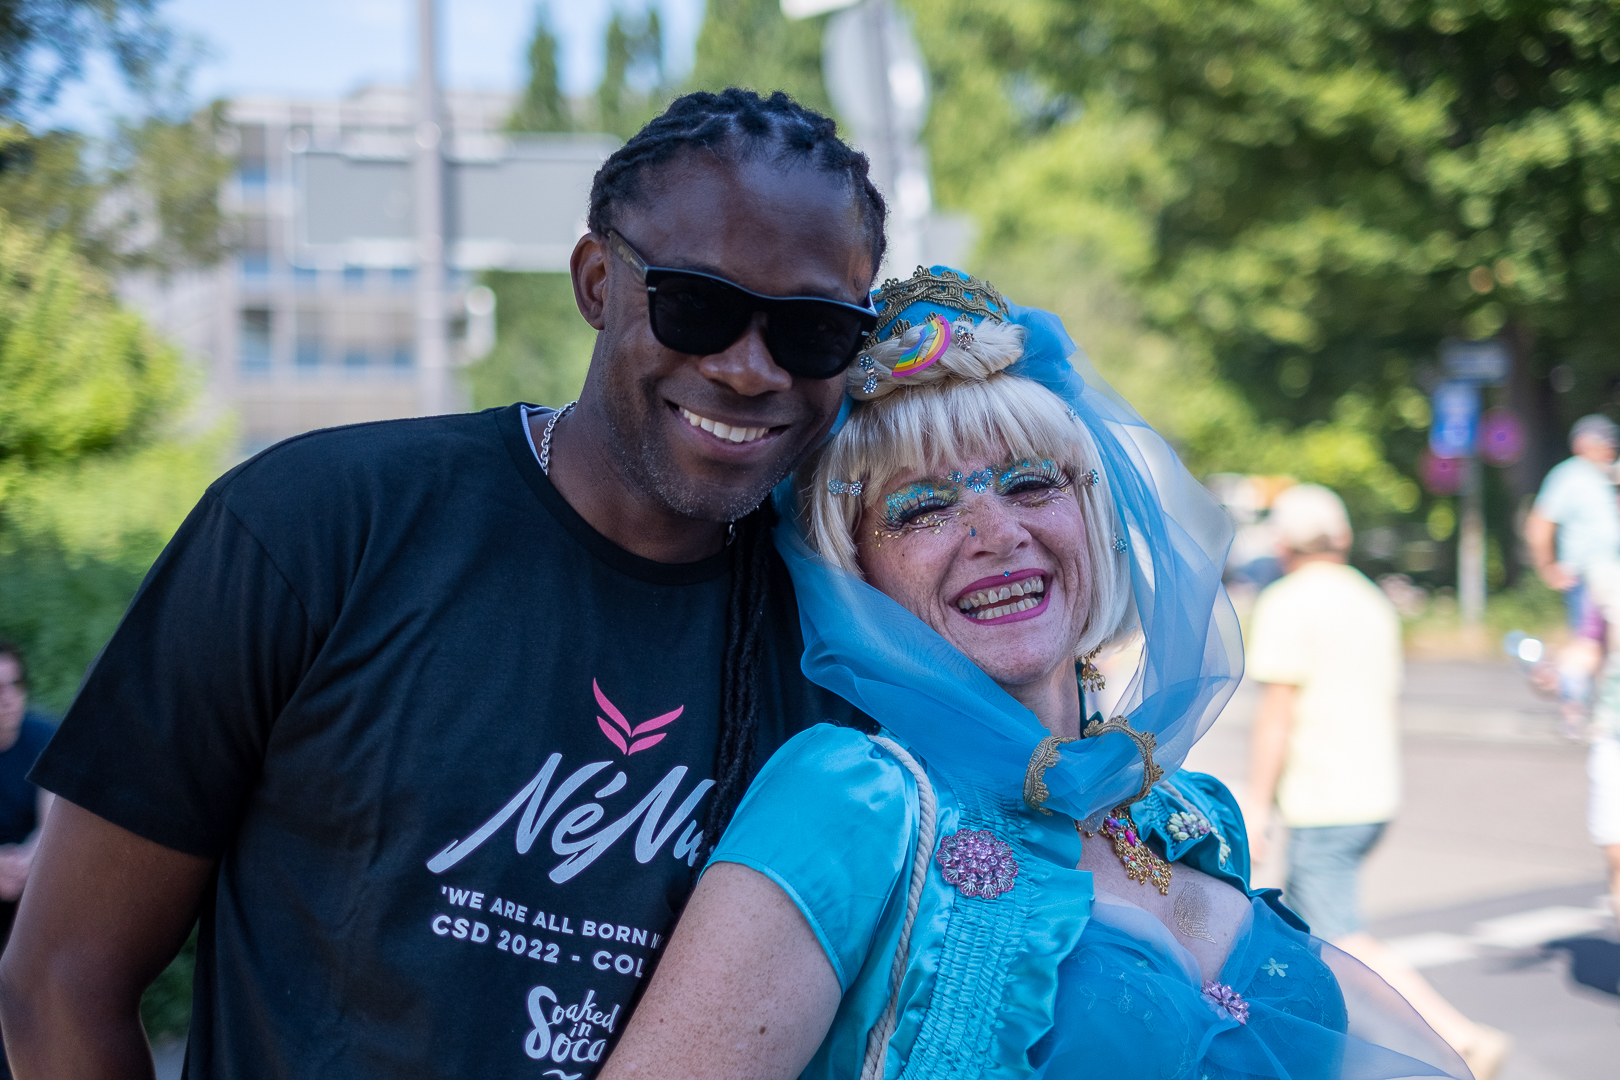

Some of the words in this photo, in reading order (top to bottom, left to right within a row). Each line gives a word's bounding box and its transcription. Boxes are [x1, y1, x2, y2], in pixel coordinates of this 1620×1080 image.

[432, 915, 490, 943] CSD
[497, 930, 560, 964] 2022
[490, 898, 528, 923] ARE
[532, 911, 574, 935] ALL
[582, 920, 648, 946] BORN
[525, 985, 620, 1046] Soaked
[569, 1022, 592, 1038] in
